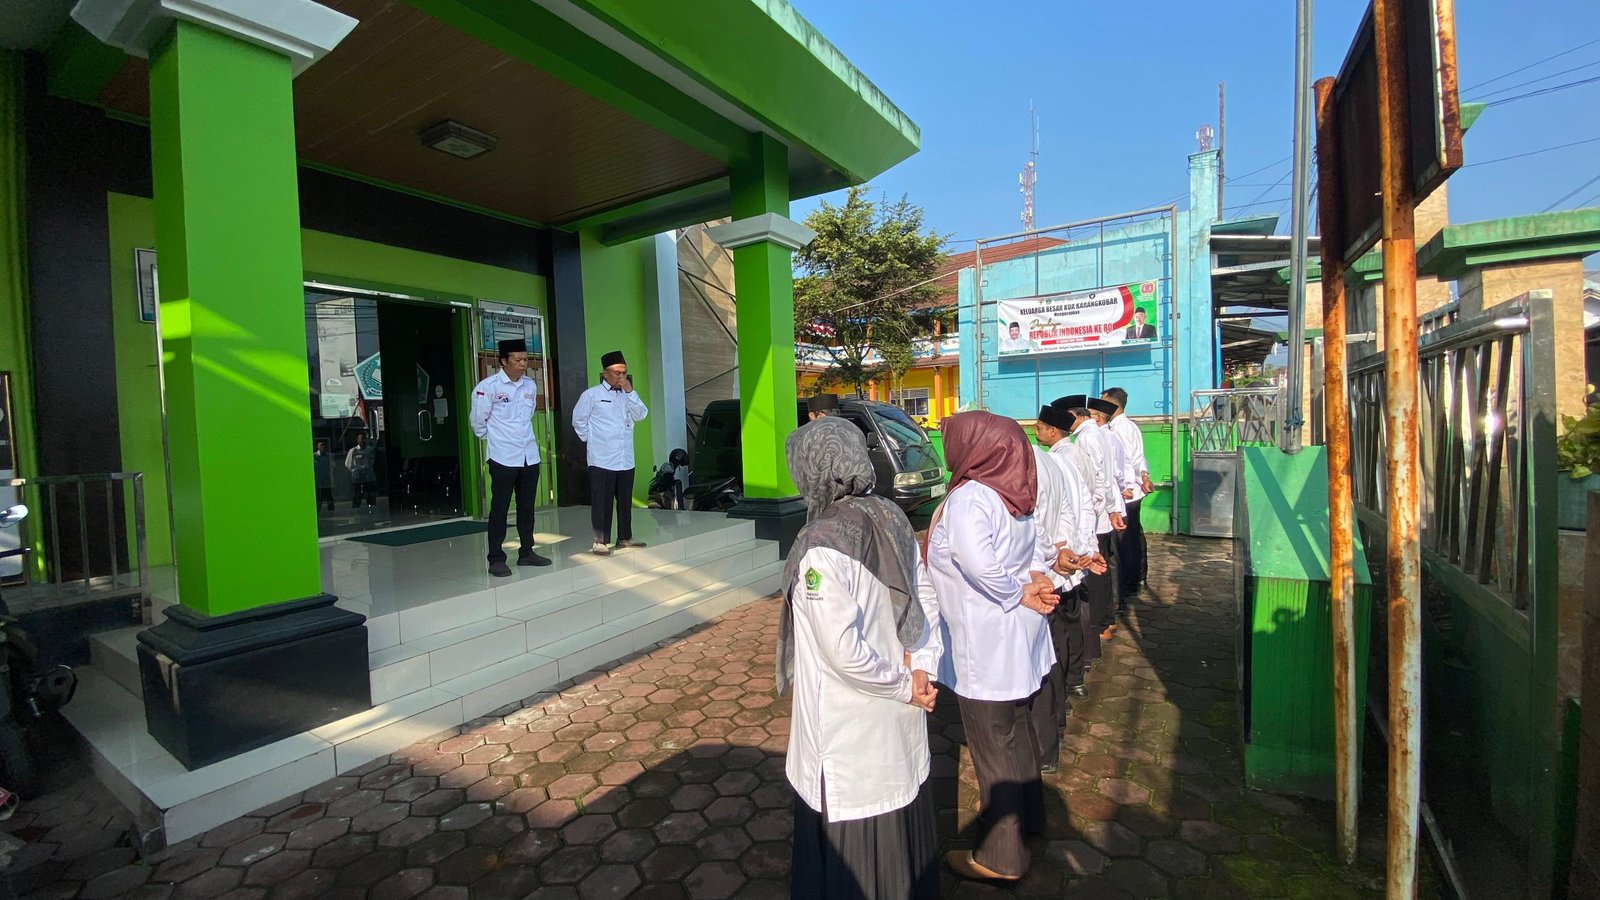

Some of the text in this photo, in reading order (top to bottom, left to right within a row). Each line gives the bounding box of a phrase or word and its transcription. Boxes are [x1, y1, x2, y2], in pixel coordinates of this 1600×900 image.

[1020, 297, 1118, 315] KELUARGA BESAR KUA KARANGKUBAR
[1029, 330, 1058, 340] REPUBLIK
[1059, 324, 1093, 337] INDONESIA
[1094, 324, 1103, 333] KE
